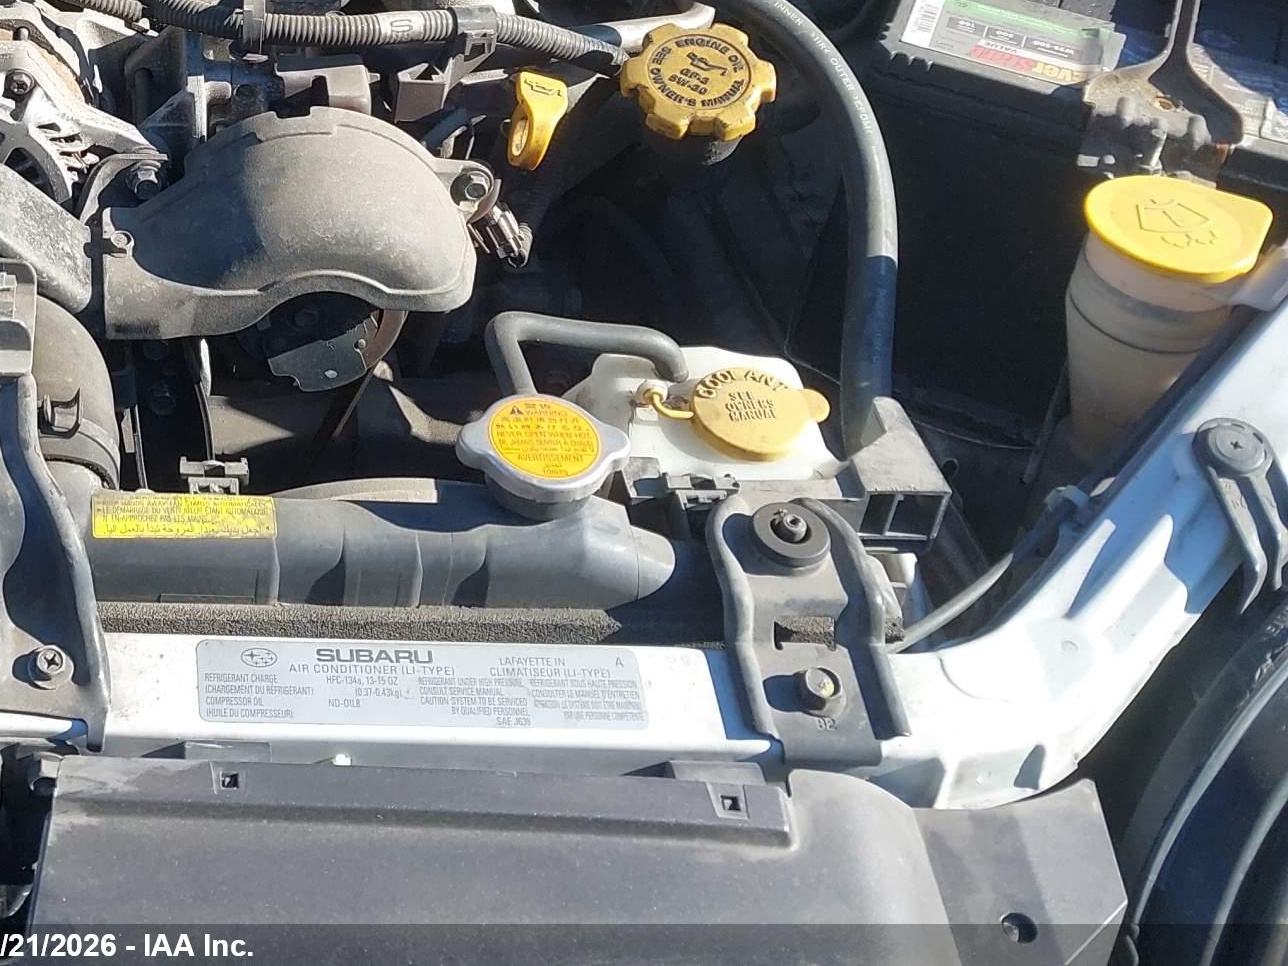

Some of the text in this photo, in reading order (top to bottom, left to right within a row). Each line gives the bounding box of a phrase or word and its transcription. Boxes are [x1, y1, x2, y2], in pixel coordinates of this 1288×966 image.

[774, 1, 803, 26] INNER
[831, 57, 855, 91] OUTER
[675, 37, 745, 73] ENGINE OIL
[650, 46, 745, 108] SEE OWNER'S MANUAL
[679, 68, 710, 85] GF-3
[668, 75, 709, 96] 5W-30
[729, 409, 777, 422] MANUAL
[517, 454, 584, 463] AVERTISSEMENT
[316, 648, 433, 664] SUBARU
[499, 657, 565, 666] LAFAYETTE IN
[615, 657, 624, 667] A
[289, 664, 455, 676] AIR CONDITIONER (LI-TYPE)
[490, 667, 611, 678] CLIMATISEUR (LI-TYPE)
[205, 673, 278, 684] REFRIGERANT CHARGE
[206, 696, 264, 707] COMPRESSOR OIL
[496, 716, 511, 726] SAE
